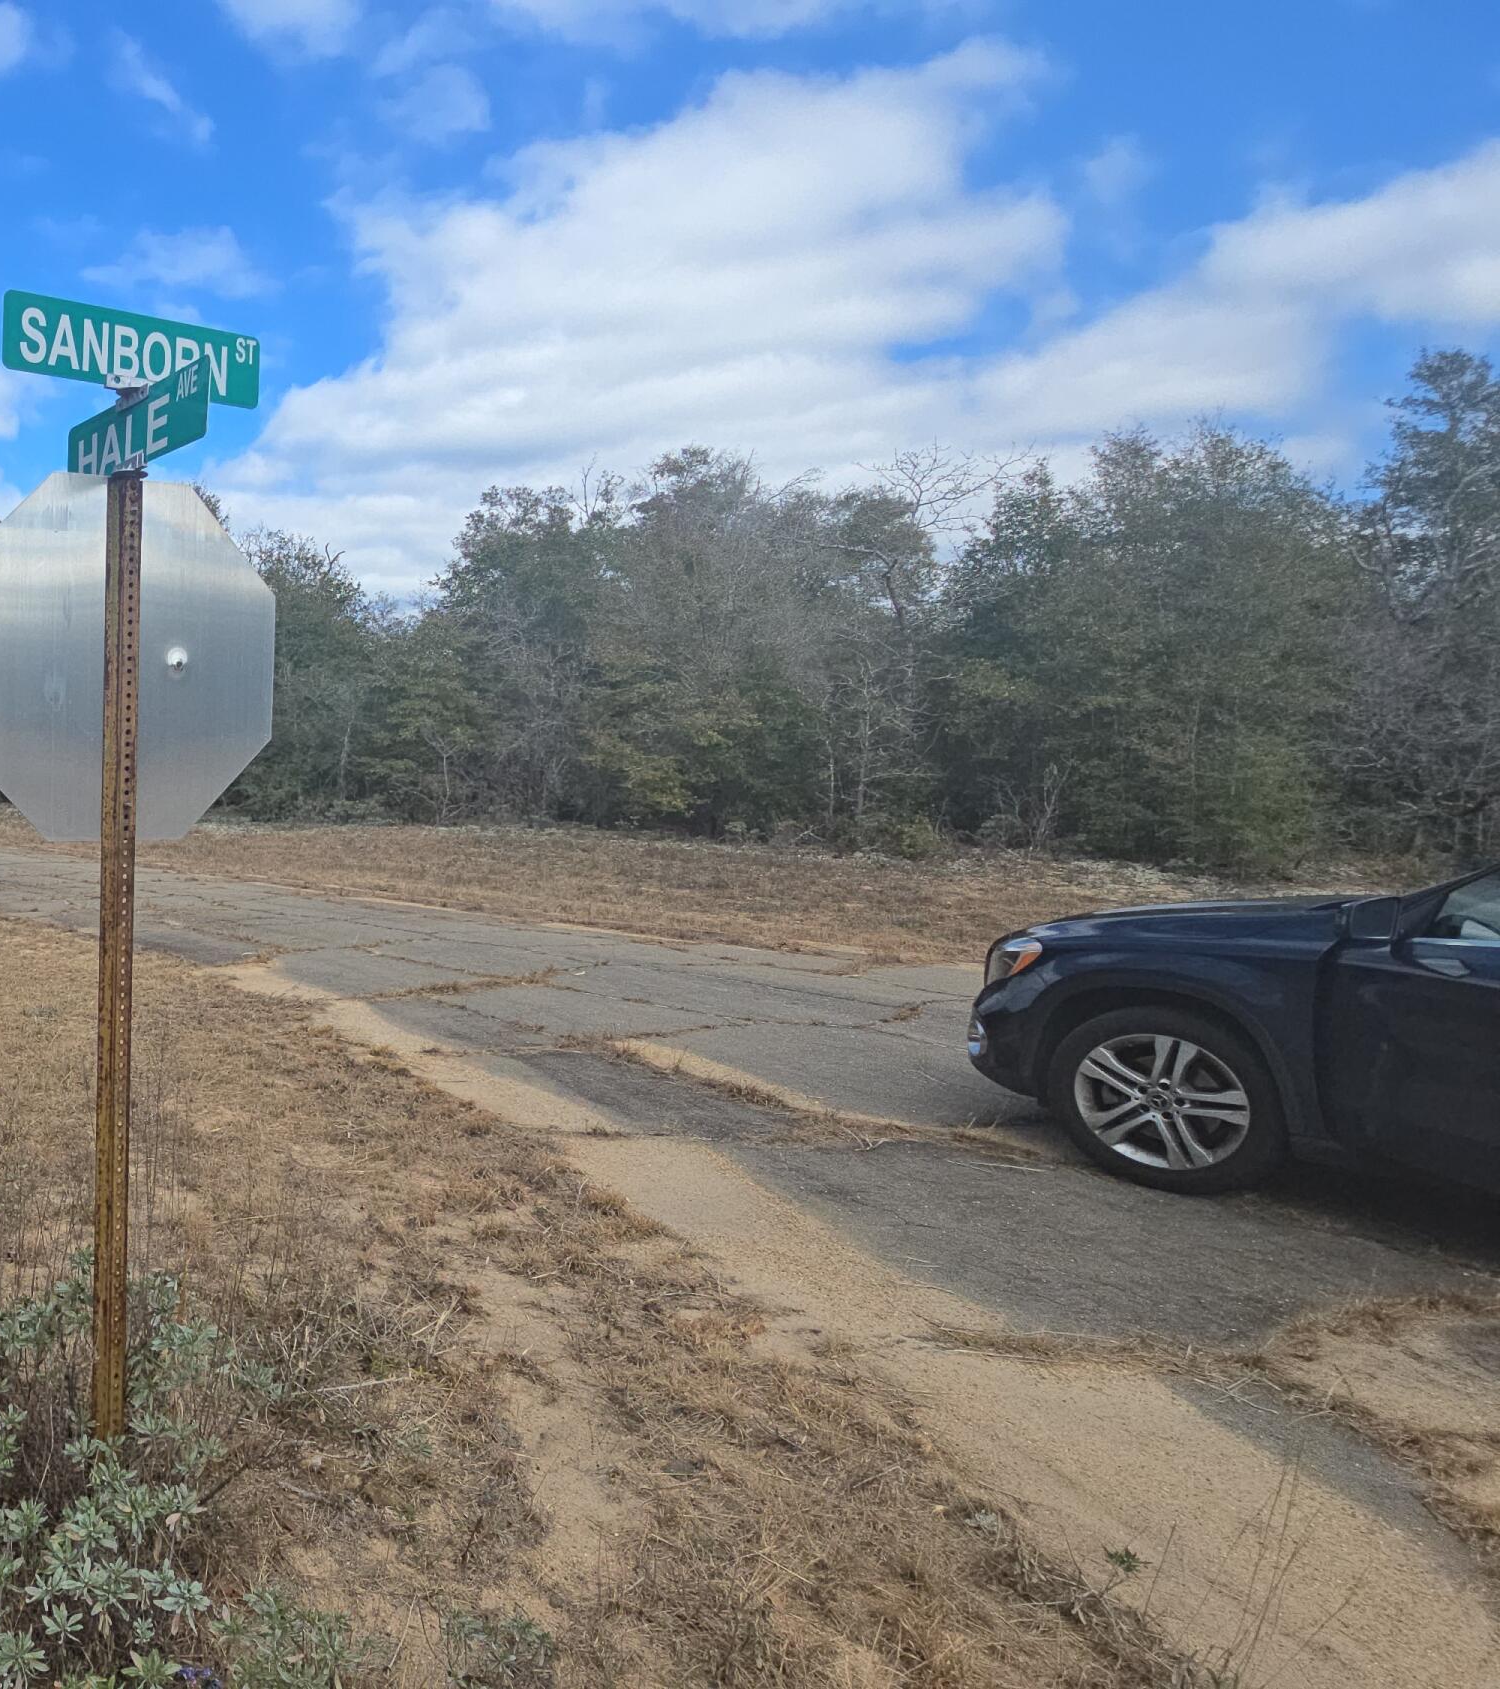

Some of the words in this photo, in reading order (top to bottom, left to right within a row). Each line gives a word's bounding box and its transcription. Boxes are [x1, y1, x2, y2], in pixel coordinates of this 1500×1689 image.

[235, 337, 257, 365] ST
[78, 393, 170, 476] HALE
[175, 363, 199, 402] AVE
